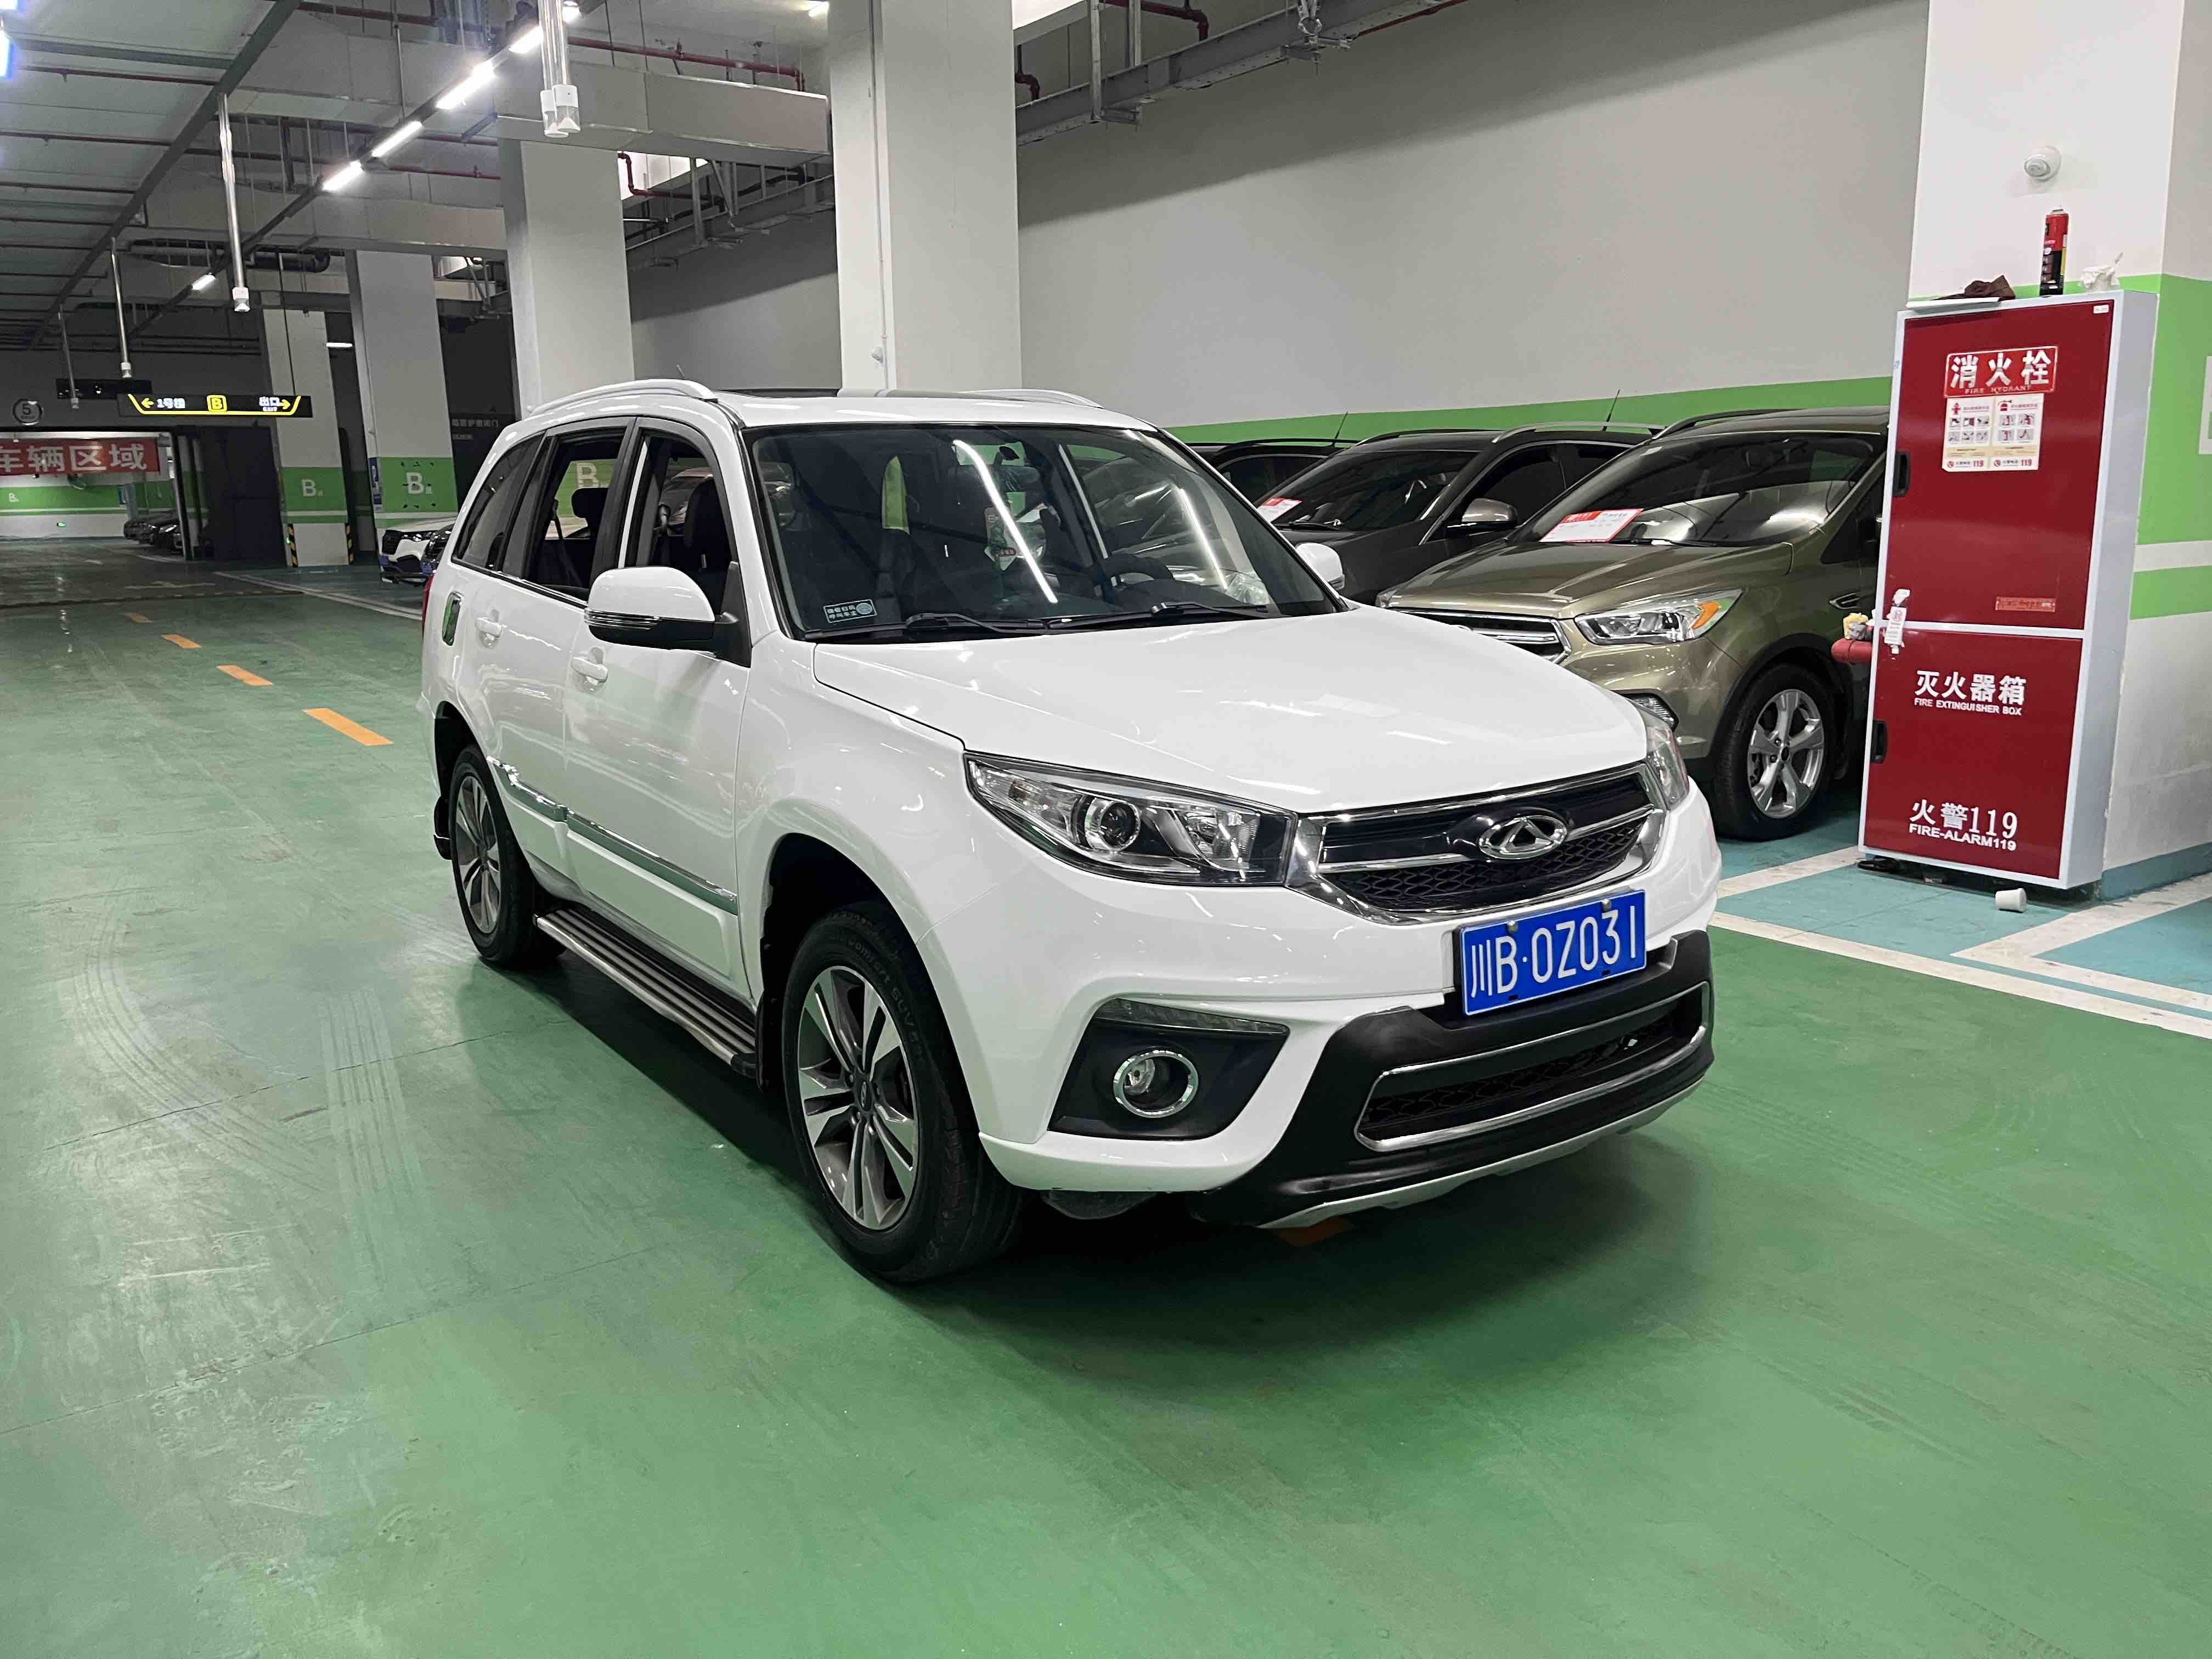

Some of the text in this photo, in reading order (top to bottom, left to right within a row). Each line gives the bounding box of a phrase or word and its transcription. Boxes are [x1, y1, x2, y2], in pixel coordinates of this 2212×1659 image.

[1950, 350, 2051, 388] 消火栓
[22, 403, 31, 415] 5
[211, 398, 223, 409] B
[259, 397, 280, 406] 出口
[1915, 670, 2026, 705] 灭火器箱
[1914, 697, 2022, 715] FIRE EXTINGUISHER BOX
[1909, 823, 2017, 851] FIRE-ALARM119
